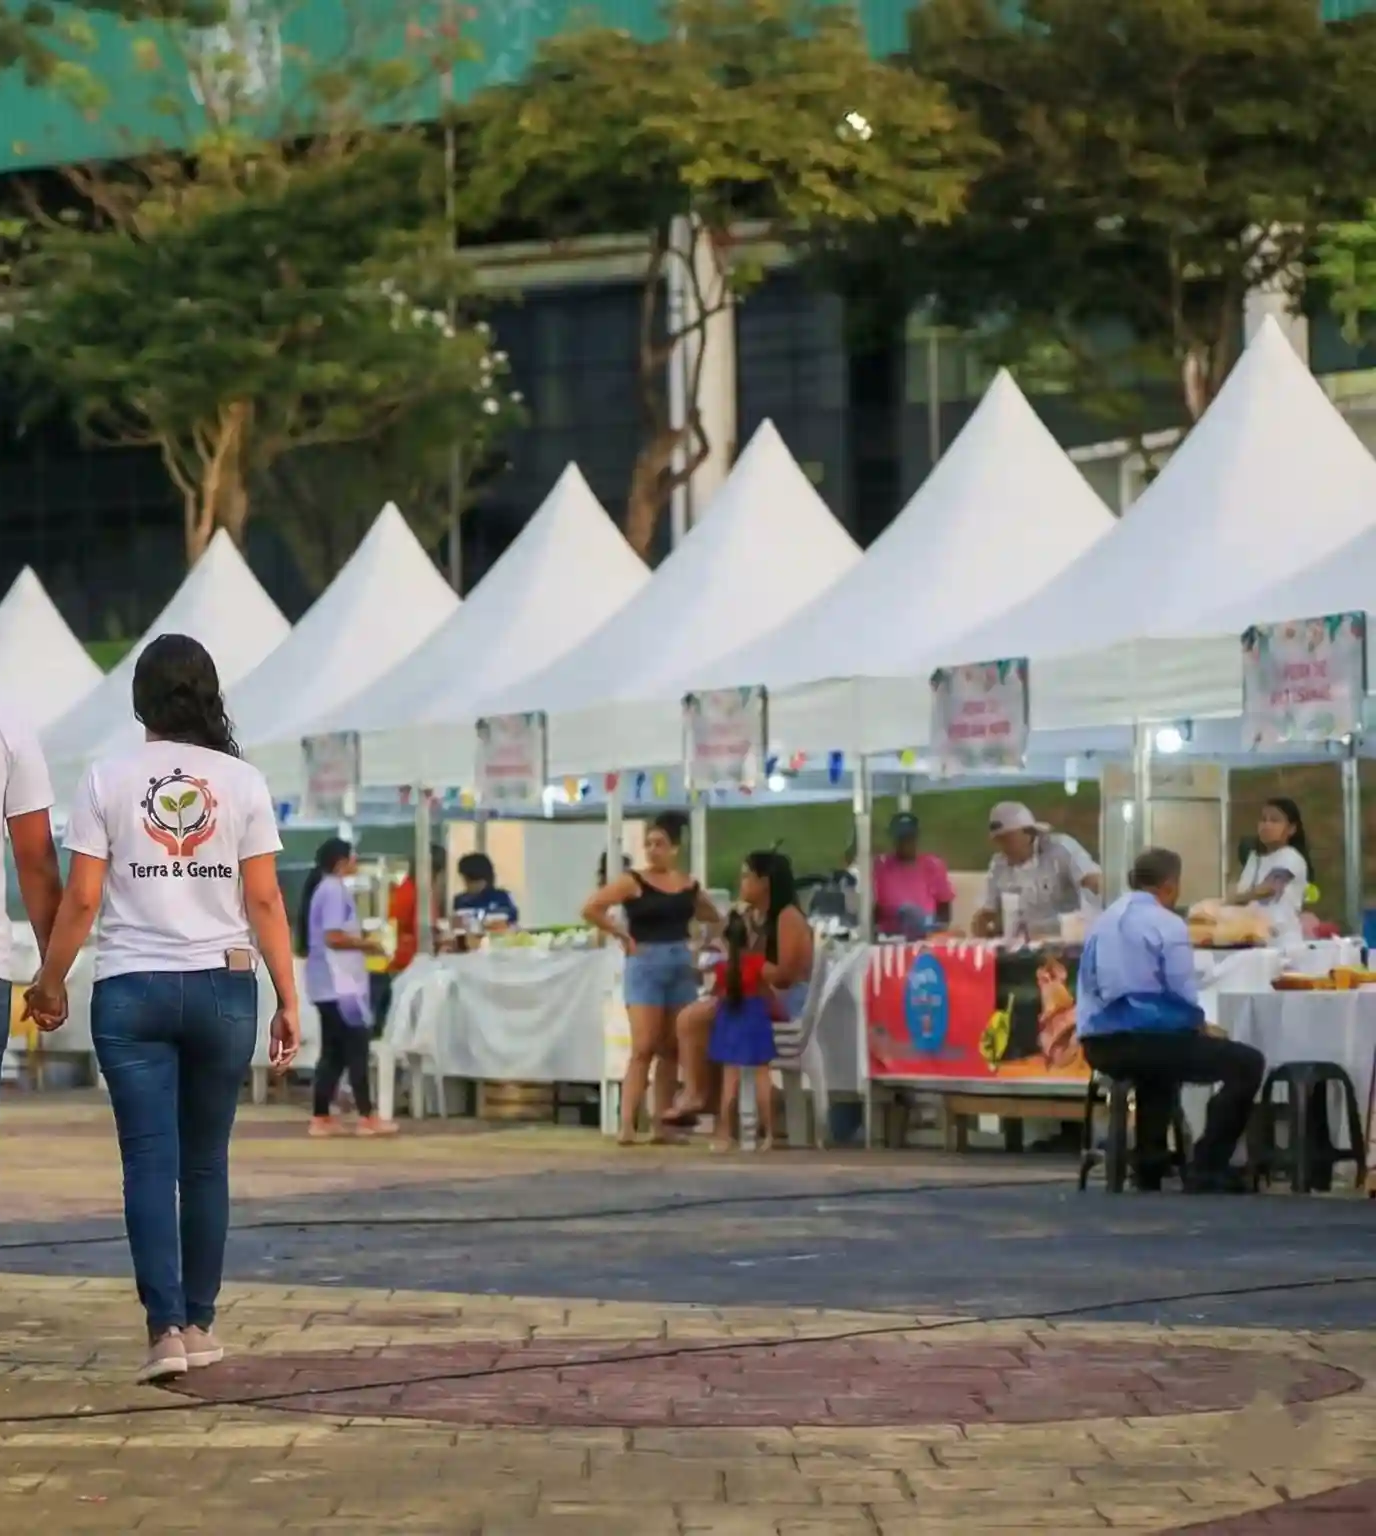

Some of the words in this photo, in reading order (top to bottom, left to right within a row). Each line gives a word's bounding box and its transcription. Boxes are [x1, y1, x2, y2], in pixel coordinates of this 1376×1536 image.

[128, 862, 169, 879] Terra
[172, 861, 184, 878] &
[186, 861, 233, 879] Gente
